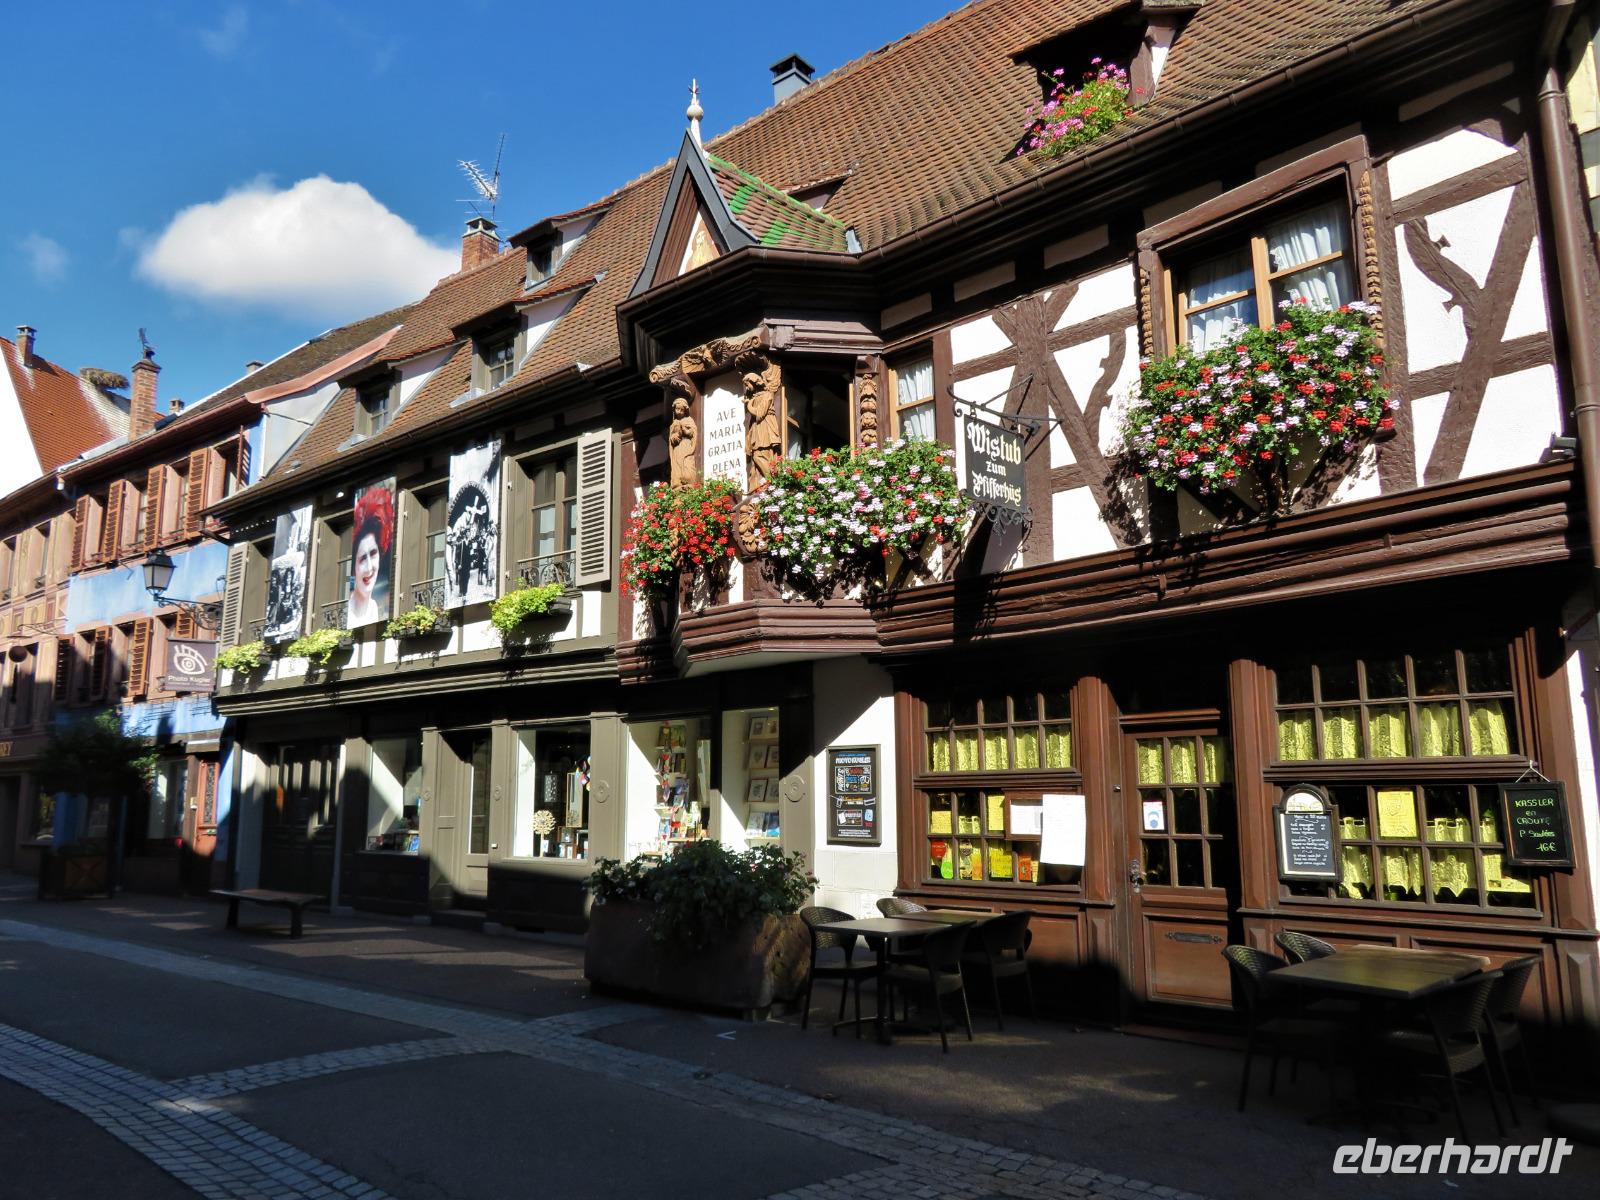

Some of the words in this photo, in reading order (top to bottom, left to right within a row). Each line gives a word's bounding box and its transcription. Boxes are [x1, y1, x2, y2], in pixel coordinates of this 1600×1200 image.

[716, 407, 737, 422] AVE
[709, 423, 742, 441] MARIA
[708, 440, 743, 458] GRATIA
[967, 422, 1021, 465] Wistub
[712, 457, 741, 474] PLENA
[985, 460, 1006, 477] zum
[971, 470, 1022, 507] Pfifferhüs
[1515, 799, 1554, 808] KASSLER
